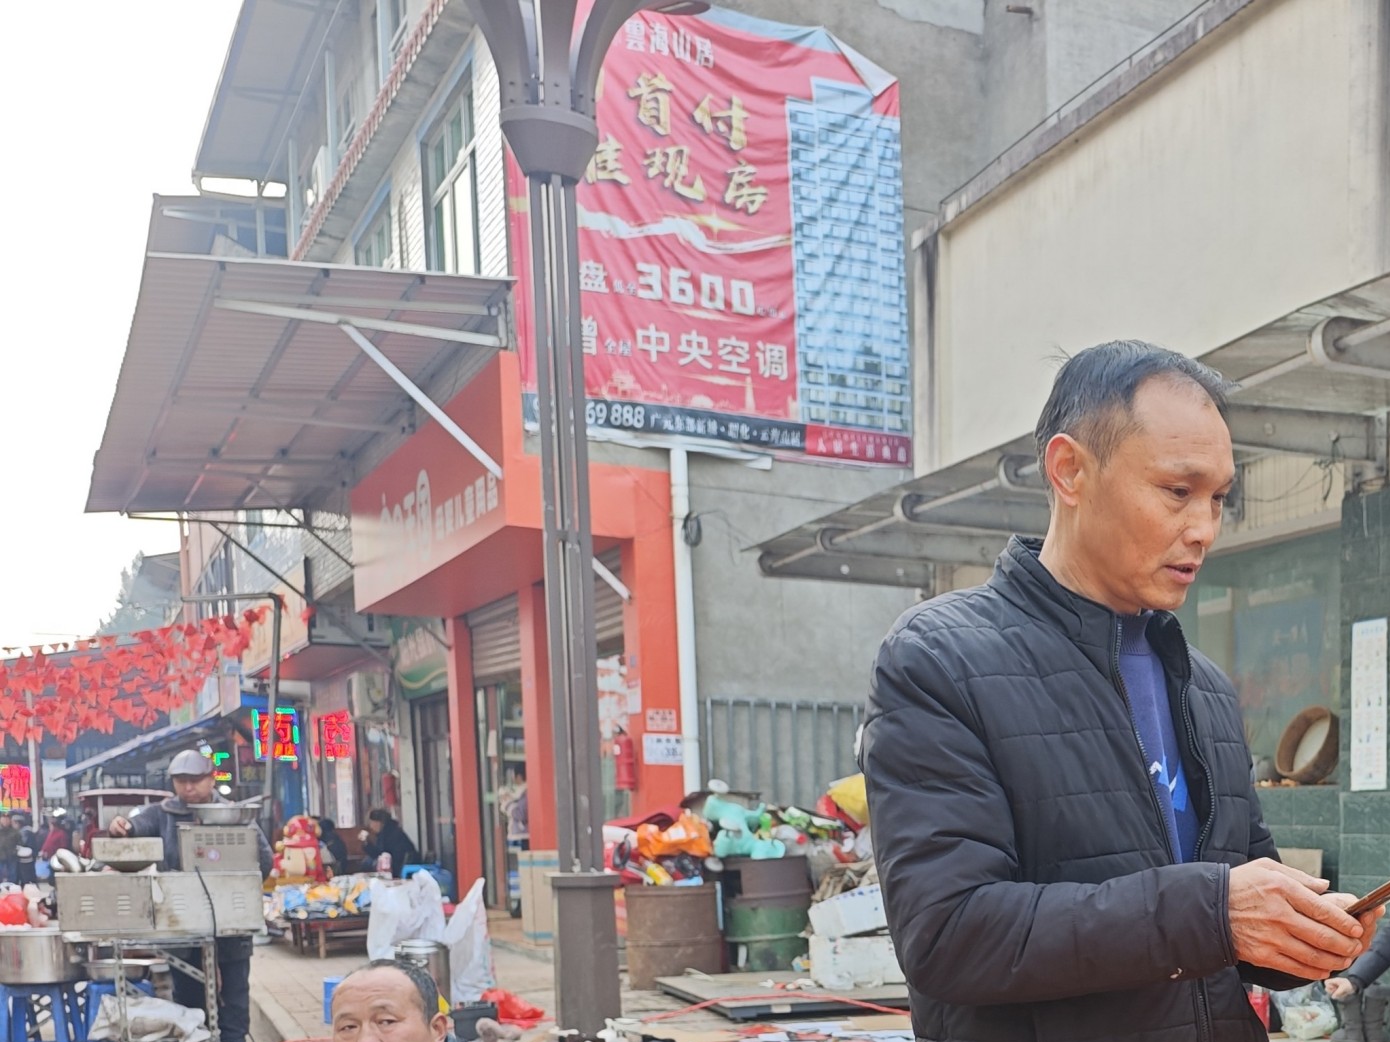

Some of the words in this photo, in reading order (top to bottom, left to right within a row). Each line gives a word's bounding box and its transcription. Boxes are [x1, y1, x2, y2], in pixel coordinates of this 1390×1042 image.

[628, 73, 749, 151] 首付
[635, 262, 756, 316] 3600
[636, 323, 789, 380] 中央空调
[610, 404, 645, 428] 888
